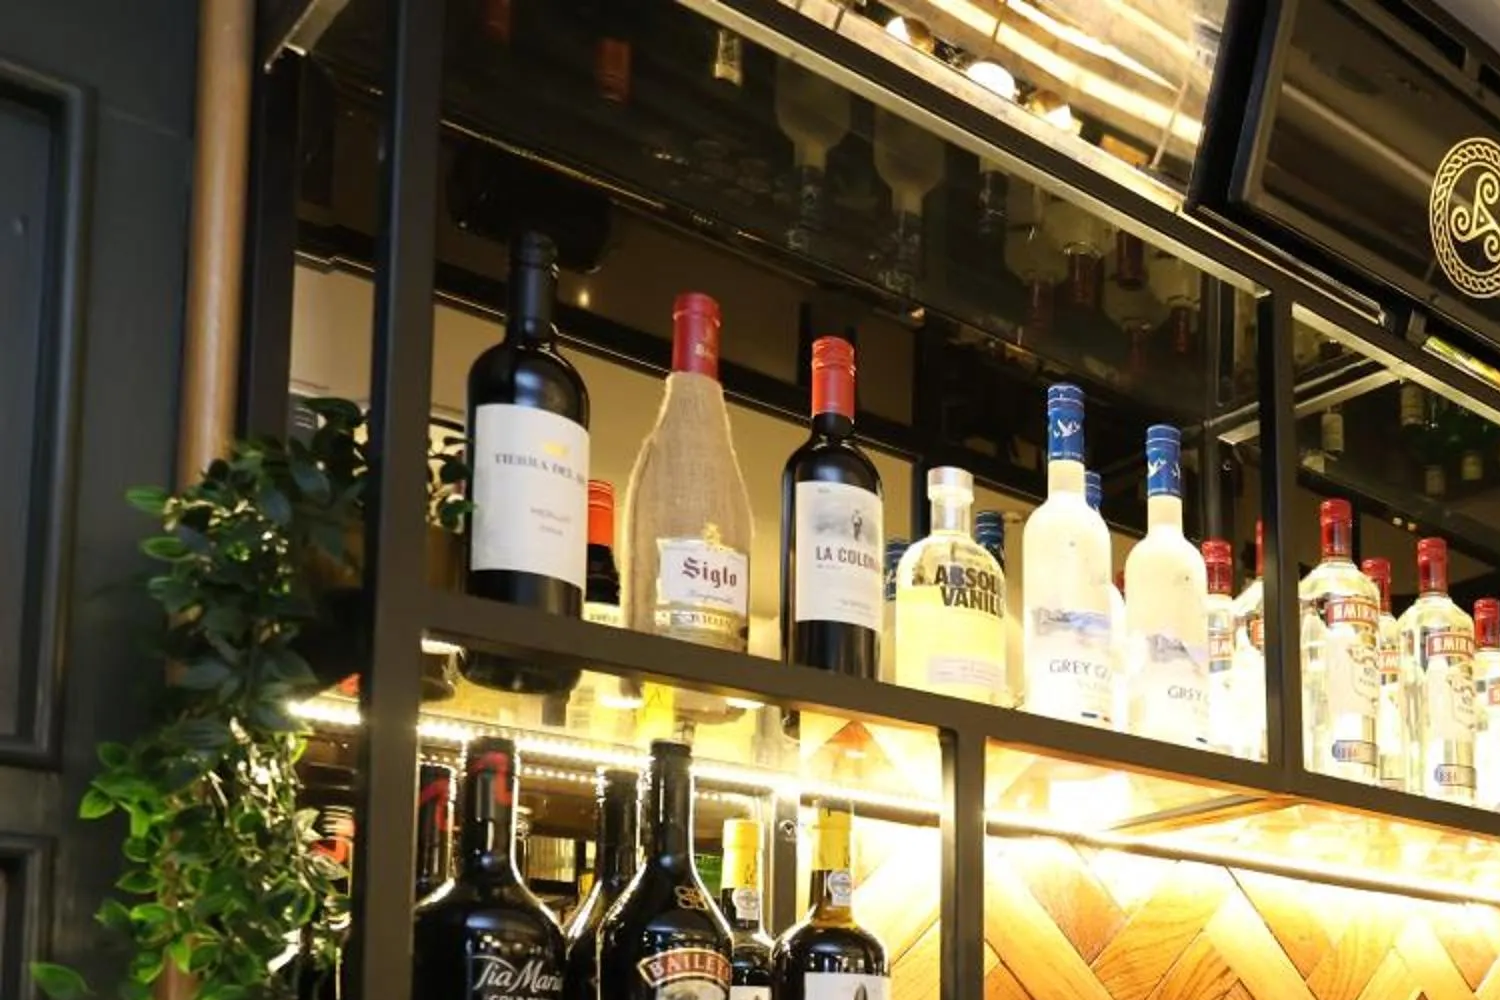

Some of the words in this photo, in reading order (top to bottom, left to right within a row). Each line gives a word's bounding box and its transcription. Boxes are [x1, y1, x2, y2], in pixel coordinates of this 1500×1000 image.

[815, 546, 832, 561] LA
[682, 556, 737, 588] Siglo
[473, 955, 518, 990] Tia
